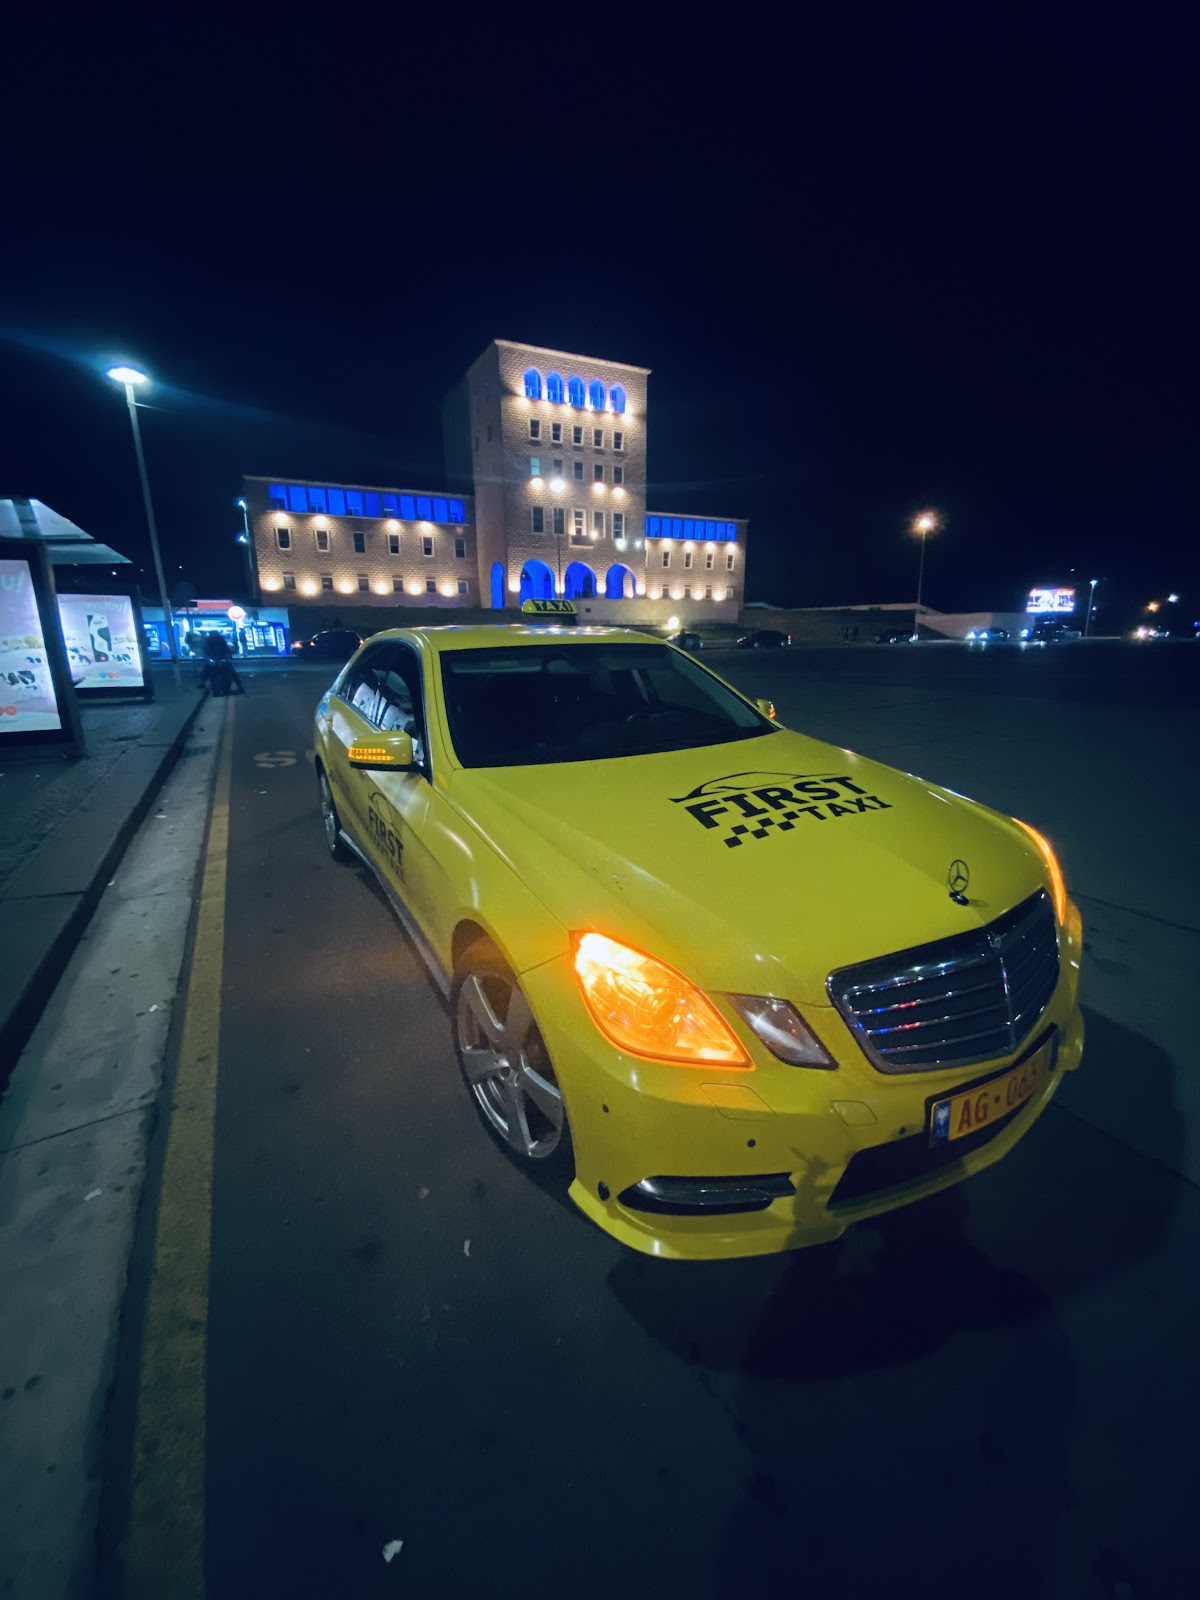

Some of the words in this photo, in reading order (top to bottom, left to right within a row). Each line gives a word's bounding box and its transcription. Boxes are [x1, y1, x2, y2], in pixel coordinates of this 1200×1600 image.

[534, 600, 572, 611] TAXI
[684, 776, 867, 829] FIRST
[797, 795, 893, 821] TAXI
[368, 806, 404, 866] FIRST
